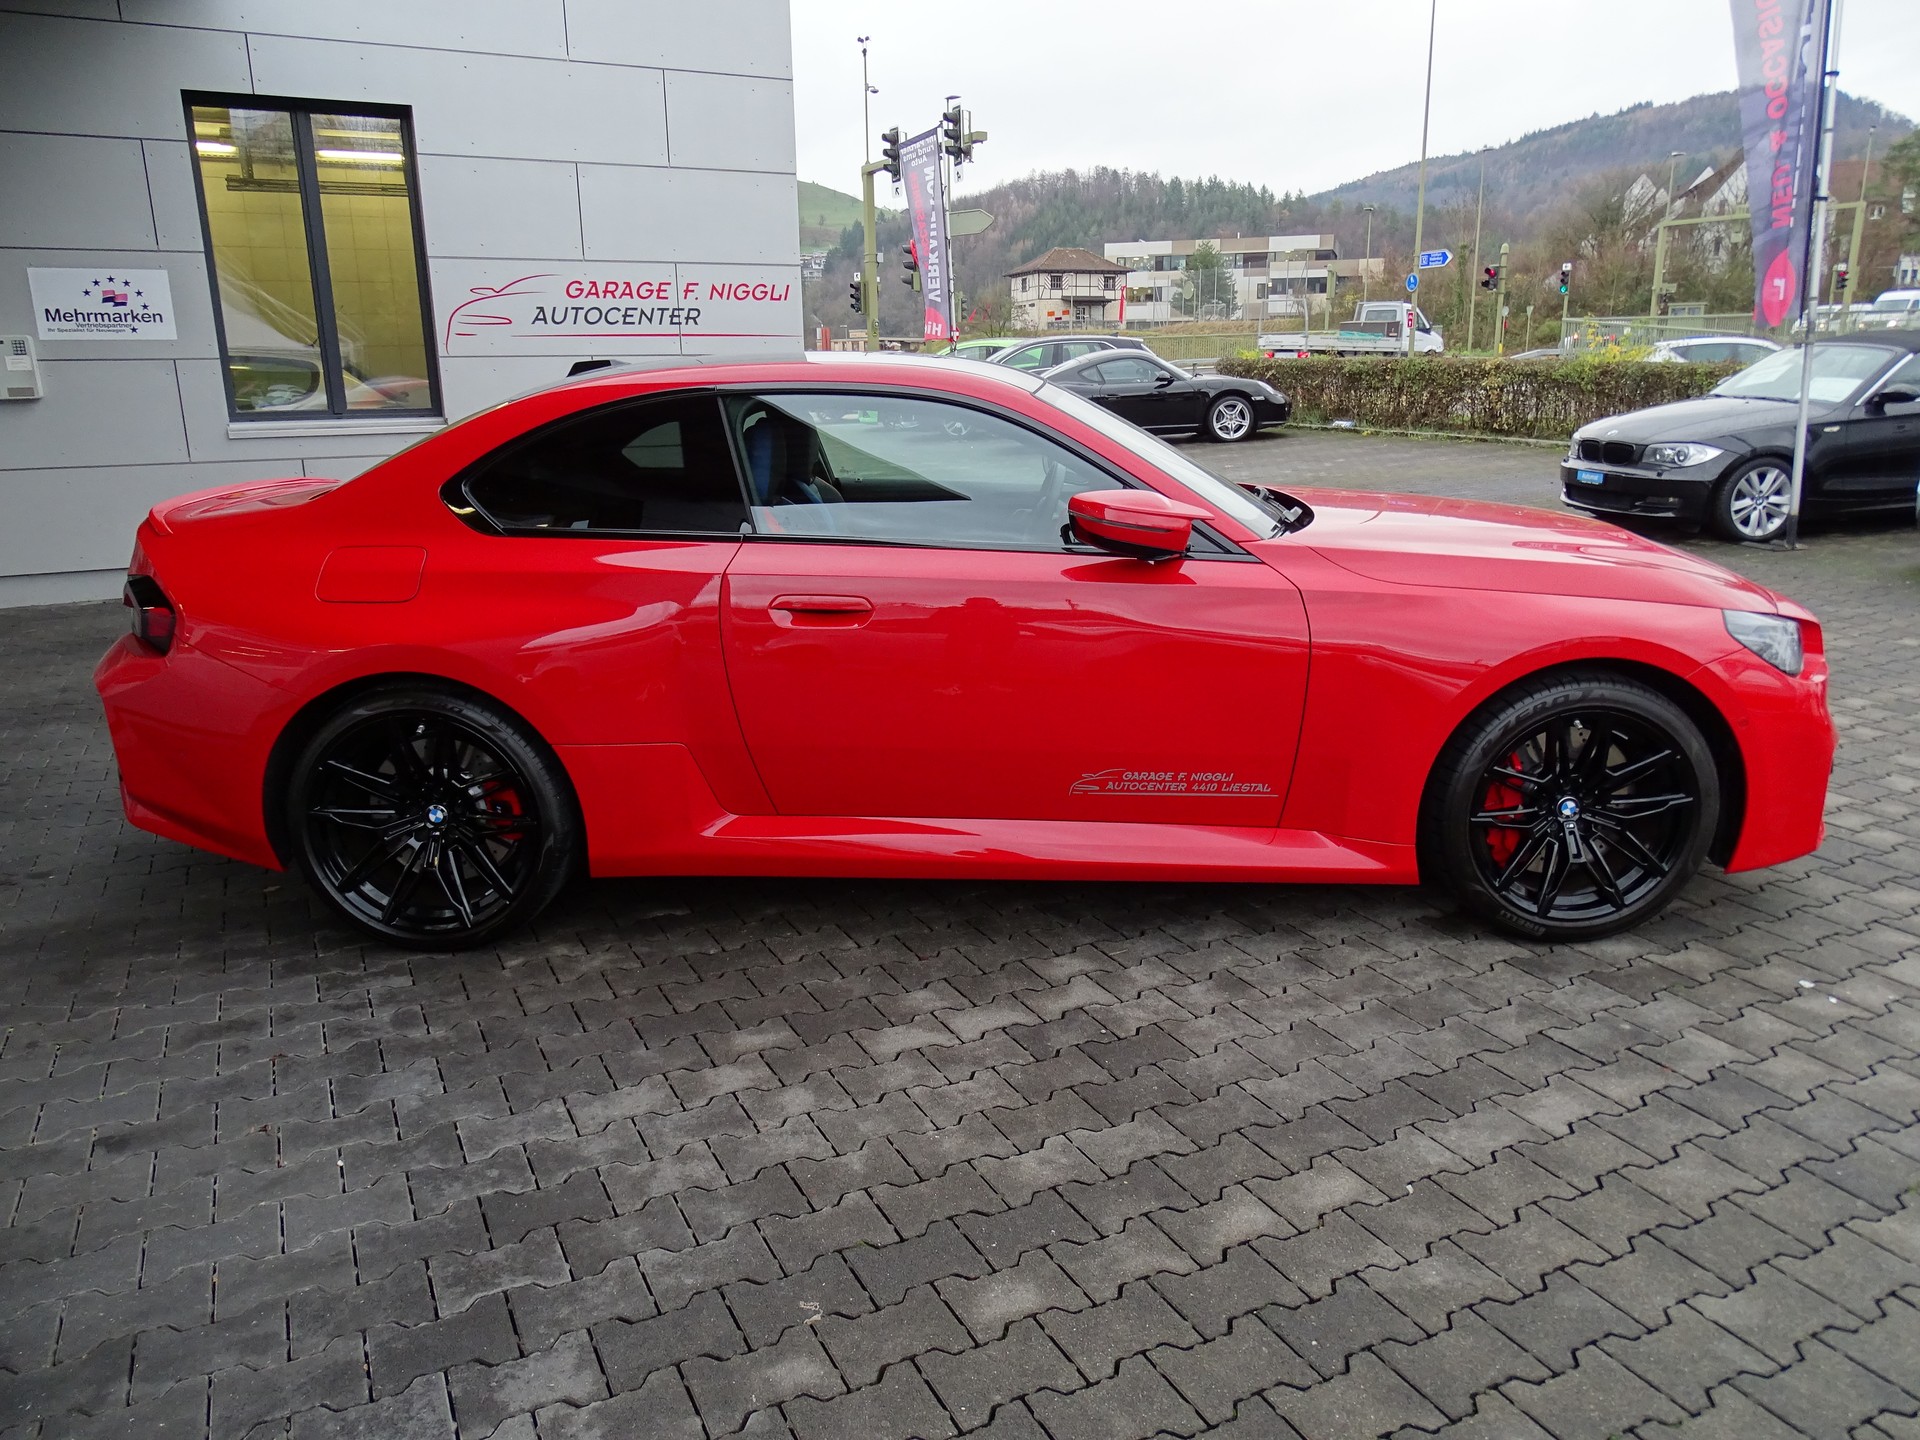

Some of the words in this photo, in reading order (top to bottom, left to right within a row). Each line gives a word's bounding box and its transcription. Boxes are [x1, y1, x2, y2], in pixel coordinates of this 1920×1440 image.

[565, 280, 672, 300] GARAGE
[683, 282, 700, 301] F.
[709, 283, 791, 301] NIGGLI
[44, 308, 164, 323] Mehrmarken
[531, 306, 702, 326] AUTOCENTER
[1122, 771, 1175, 781] GARAGE
[1177, 772, 1187, 781] F.
[1190, 772, 1235, 782] NIGGLI
[1105, 781, 1187, 792] AUTOCENTER
[1191, 783, 1218, 792] 4410
[1221, 783, 1272, 793] LIESTAL
